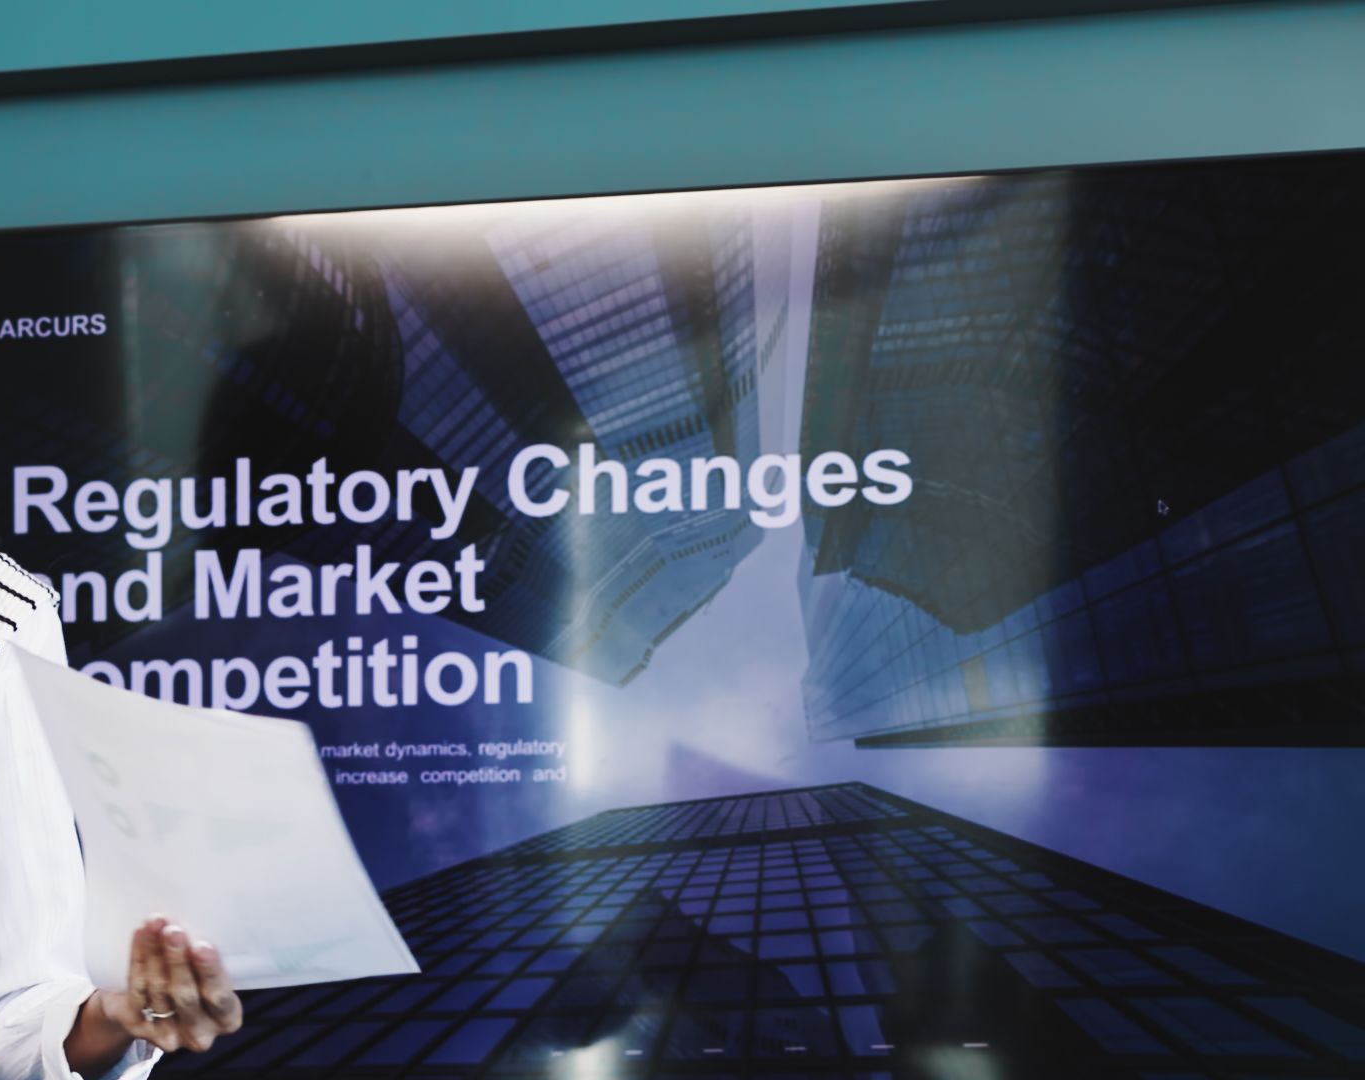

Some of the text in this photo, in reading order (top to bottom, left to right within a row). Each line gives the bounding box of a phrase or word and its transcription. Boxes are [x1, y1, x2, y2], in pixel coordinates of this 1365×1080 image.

[12, 443, 913, 549] Regulatory Changes
[29, 545, 486, 623] nd Market
[321, 738, 566, 760] market dynamics, regulatory
[336, 765, 567, 786] increase competition and
